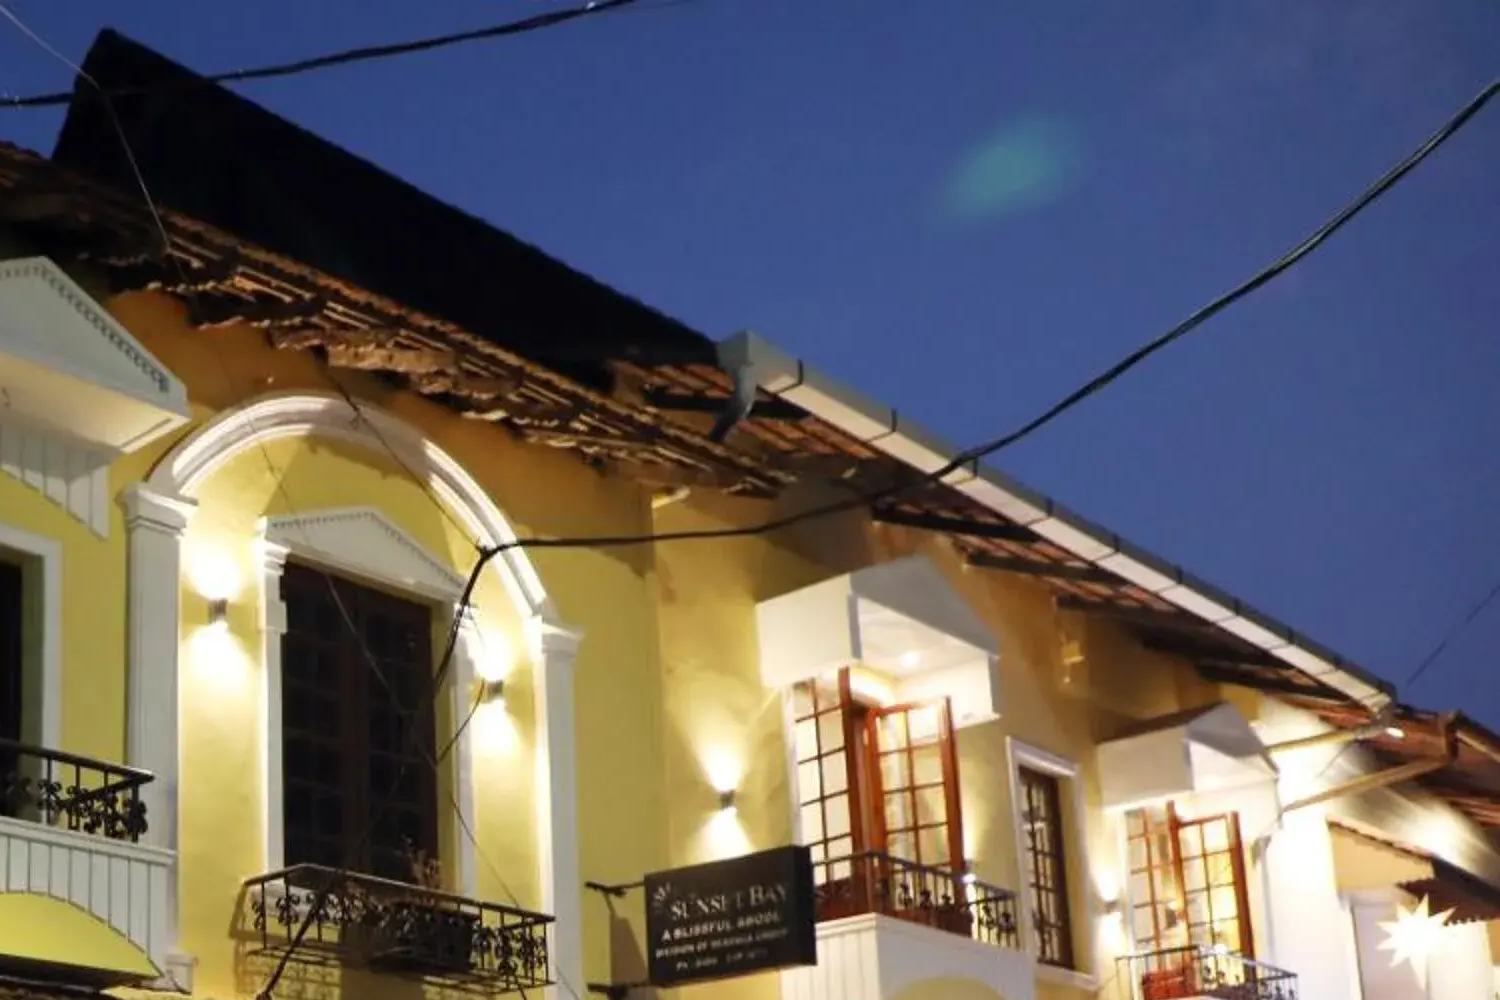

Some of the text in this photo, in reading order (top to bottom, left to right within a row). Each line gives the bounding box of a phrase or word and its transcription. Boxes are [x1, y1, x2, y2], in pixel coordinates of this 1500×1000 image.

[749, 883, 788, 906] BAY
[661, 929, 672, 942] A
[673, 919, 732, 940] BLISSFUL
